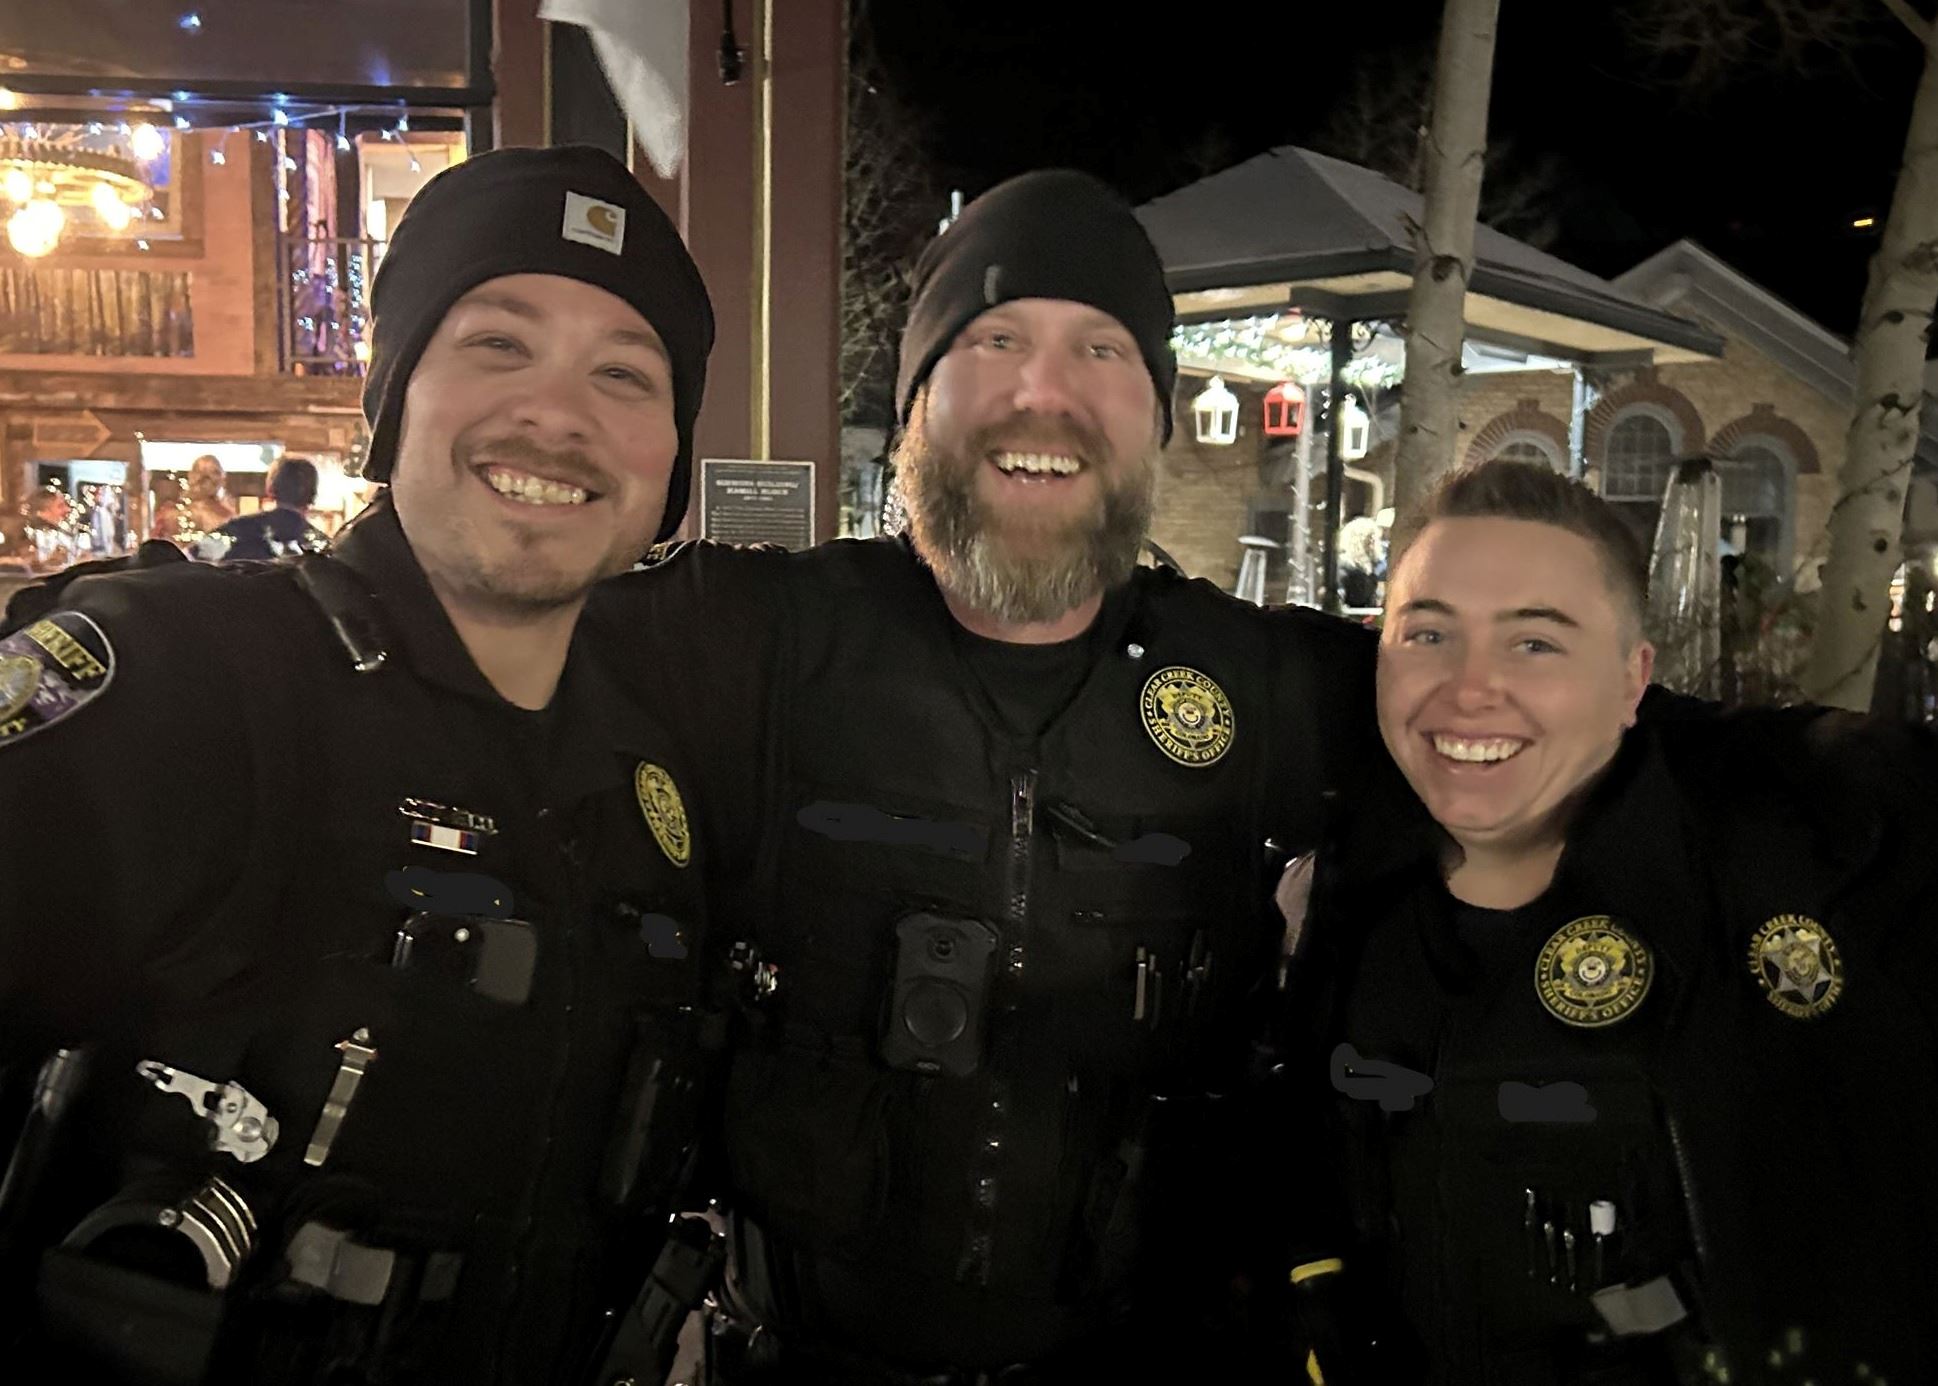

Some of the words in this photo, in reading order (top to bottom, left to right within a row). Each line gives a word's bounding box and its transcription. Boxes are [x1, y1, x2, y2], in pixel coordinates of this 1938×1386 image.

[1145, 678, 1163, 710] CLEAR
[1160, 670, 1195, 682] CREEK
[1196, 675, 1232, 717] COUNTY
[1201, 727, 1232, 759] OFFICE
[1541, 932, 1568, 972] CLEAR
[1566, 918, 1610, 937] CREEK
[1601, 979, 1644, 1018] OFFICE
